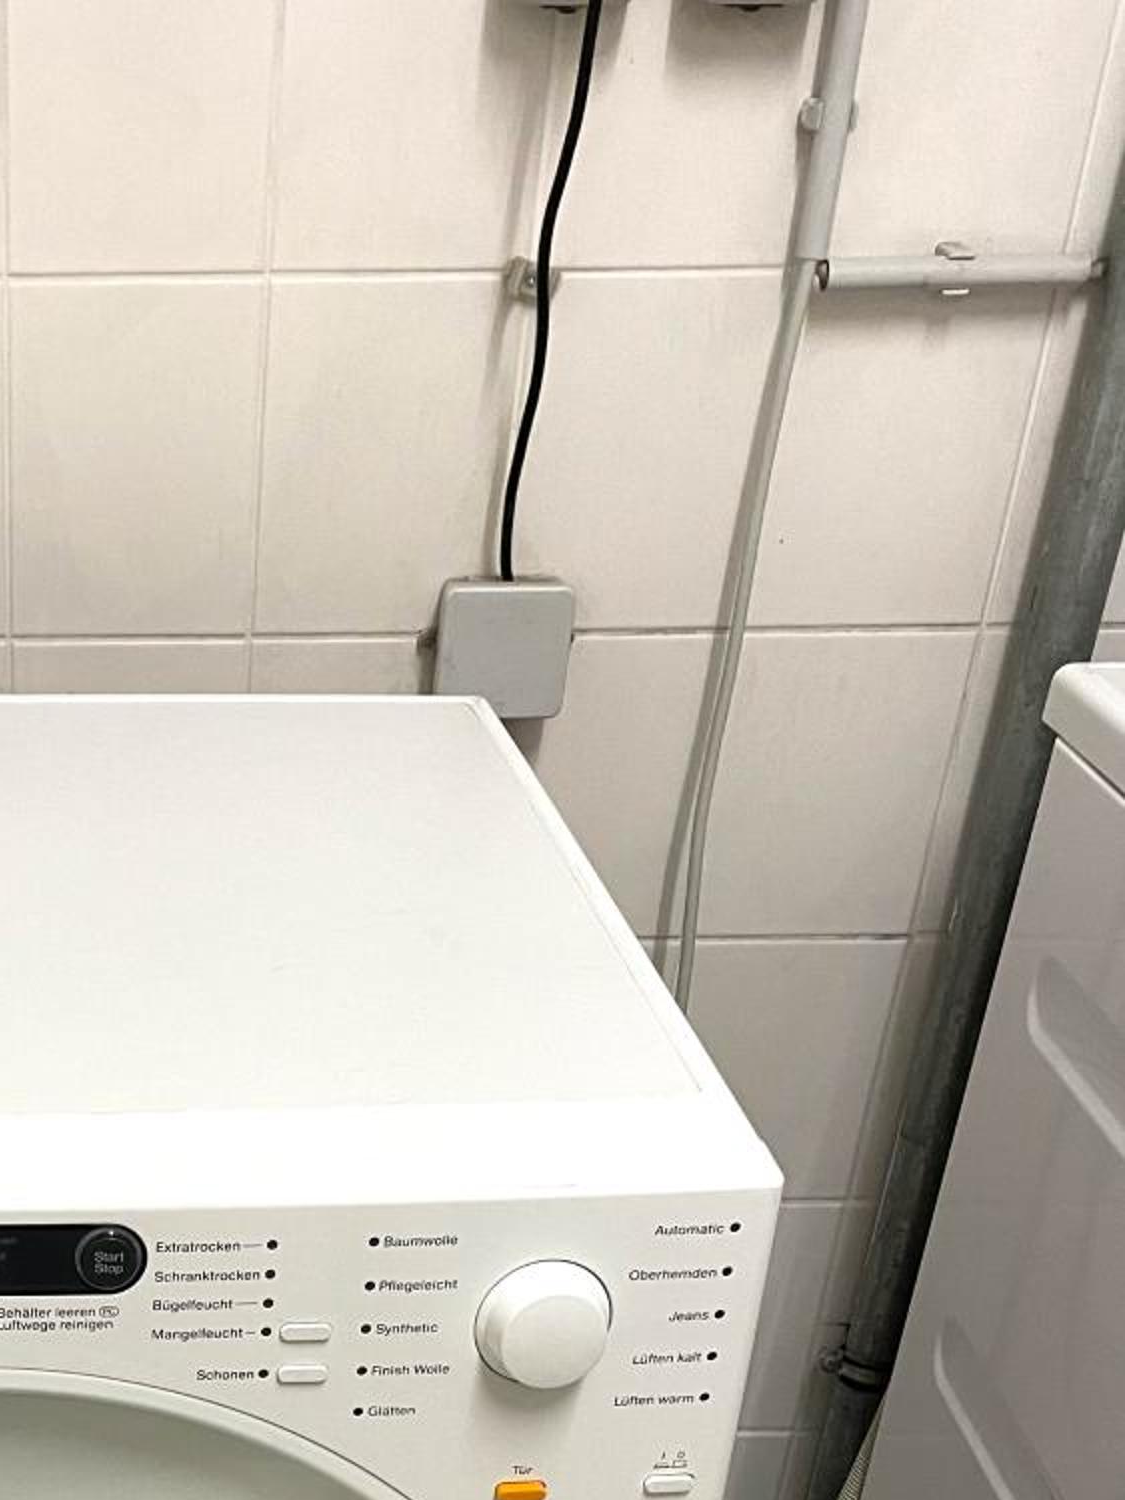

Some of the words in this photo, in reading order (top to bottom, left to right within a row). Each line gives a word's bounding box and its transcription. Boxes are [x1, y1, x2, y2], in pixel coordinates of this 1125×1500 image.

[655, 1225, 724, 1235] Automatic
[156, 1242, 240, 1252] Extratrocken
[384, 1236, 458, 1247] Baumwolle
[94, 1250, 124, 1262] Start
[94, 1262, 124, 1275] Stop
[629, 1268, 717, 1280] Oberhemden
[155, 1270, 260, 1282] Schranktrocken
[379, 1280, 457, 1293] Pflegeleicht
[153, 1300, 232, 1312] Bügelfeucht
[55, 1308, 95, 1318] leeren
[669, 1312, 709, 1322] Jeans
[60, 1321, 113, 1332] reinigen
[376, 1324, 437, 1336] Synthetic
[152, 1328, 243, 1342] Mangelfeucht
[632, 1352, 674, 1365] Lüften
[677, 1351, 702, 1363] kalt
[197, 1369, 254, 1381] Schonen
[371, 1365, 410, 1376] Finish
[414, 1364, 450, 1375] Wolle
[614, 1396, 654, 1406] Lüften
[659, 1396, 694, 1404] warm
[367, 1405, 416, 1417] Glätten
[512, 1465, 534, 1476] Tür
